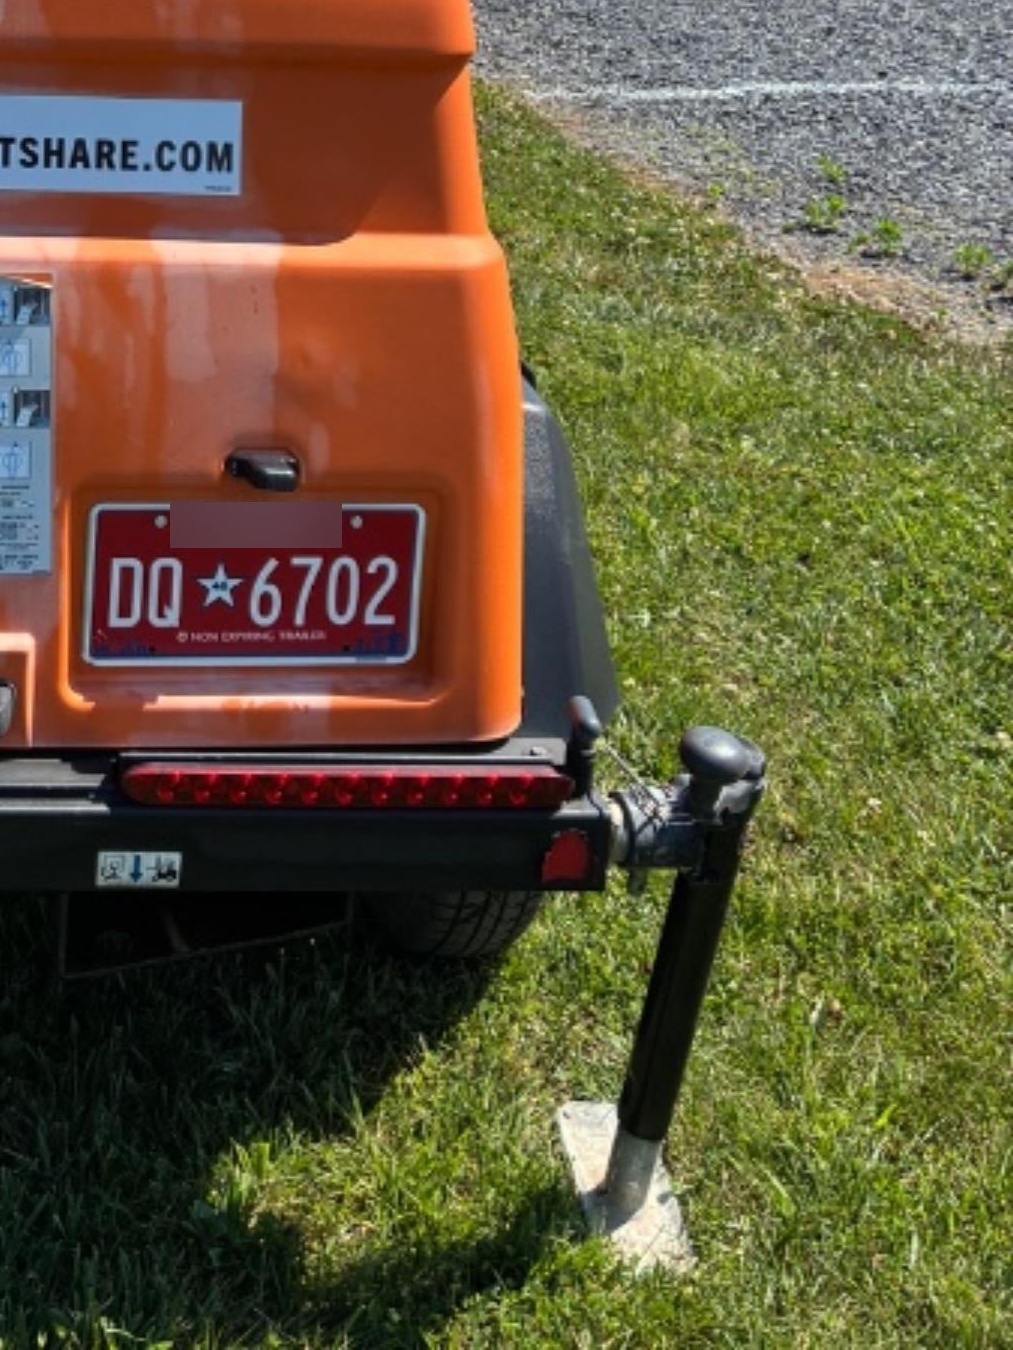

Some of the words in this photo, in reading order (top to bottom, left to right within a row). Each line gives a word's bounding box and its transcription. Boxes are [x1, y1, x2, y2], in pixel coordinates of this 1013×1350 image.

[107, 557, 183, 629] DQ
[249, 555, 399, 627] 6702
[190, 631, 219, 643] NON
[279, 630, 327, 641] TRAILER
